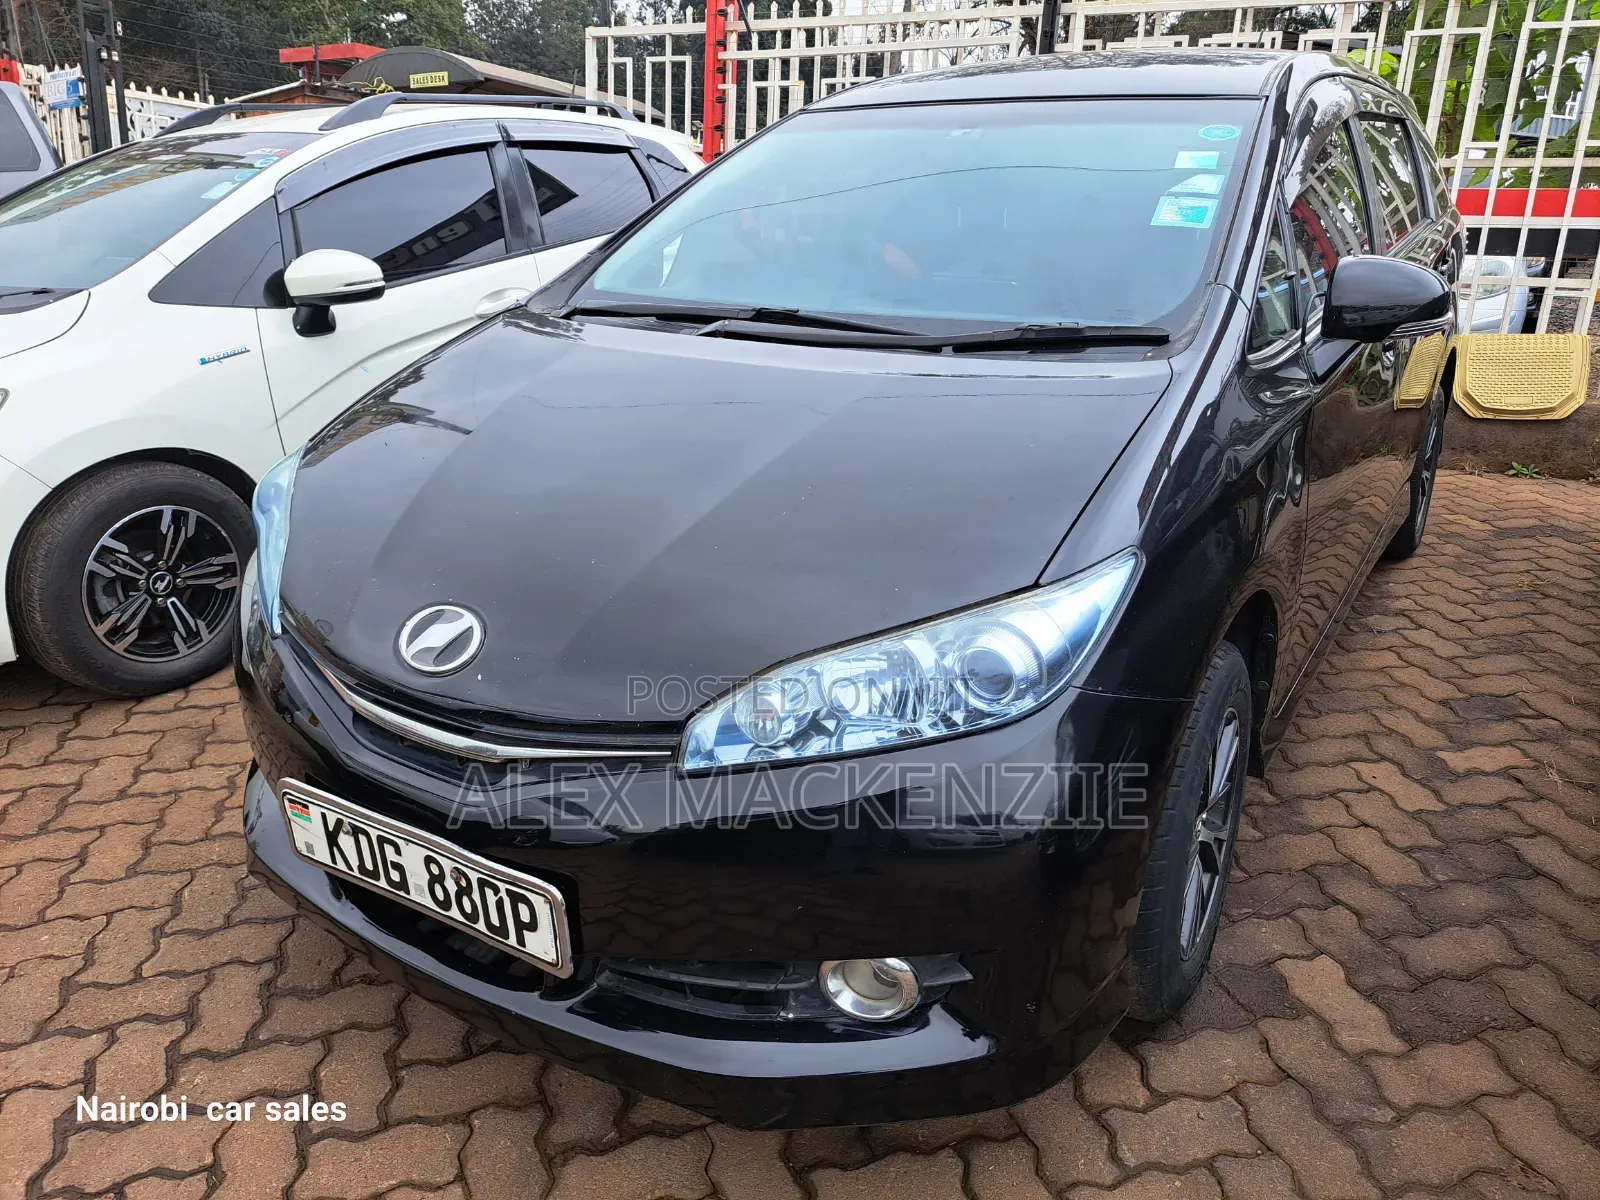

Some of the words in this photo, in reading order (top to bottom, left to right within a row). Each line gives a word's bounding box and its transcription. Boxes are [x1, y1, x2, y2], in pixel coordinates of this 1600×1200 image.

[412, 76, 429, 85] SALES
[430, 75, 446, 83] DESK
[207, 347, 247, 362] HYBRID
[321, 811, 411, 895] KDG
[424, 854, 539, 948] 880P
